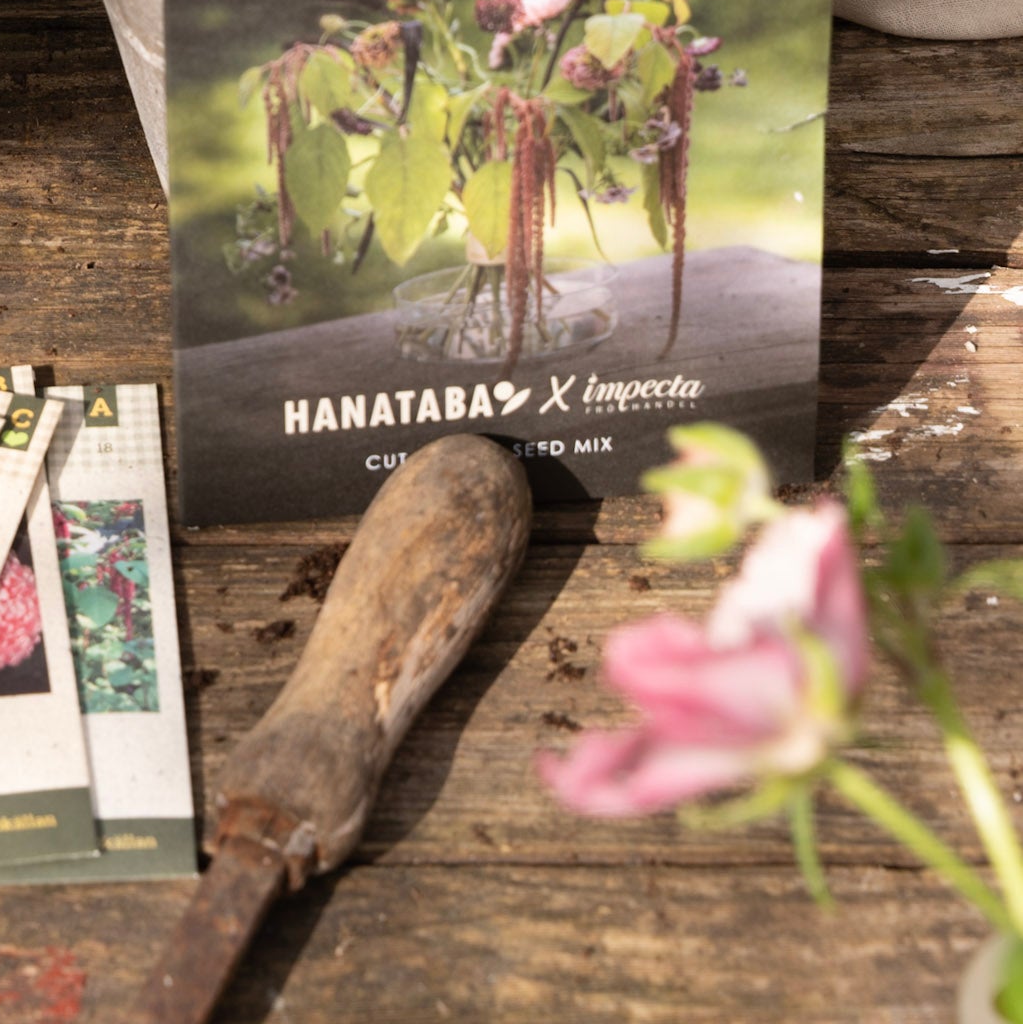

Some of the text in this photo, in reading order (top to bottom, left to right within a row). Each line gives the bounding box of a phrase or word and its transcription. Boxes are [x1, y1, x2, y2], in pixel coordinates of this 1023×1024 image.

[89, 397, 113, 417] A
[284, 372, 706, 435] HANATABA X impecta
[11, 408, 34, 429] C
[512, 440, 565, 457] SEED
[574, 436, 613, 453] MIX
